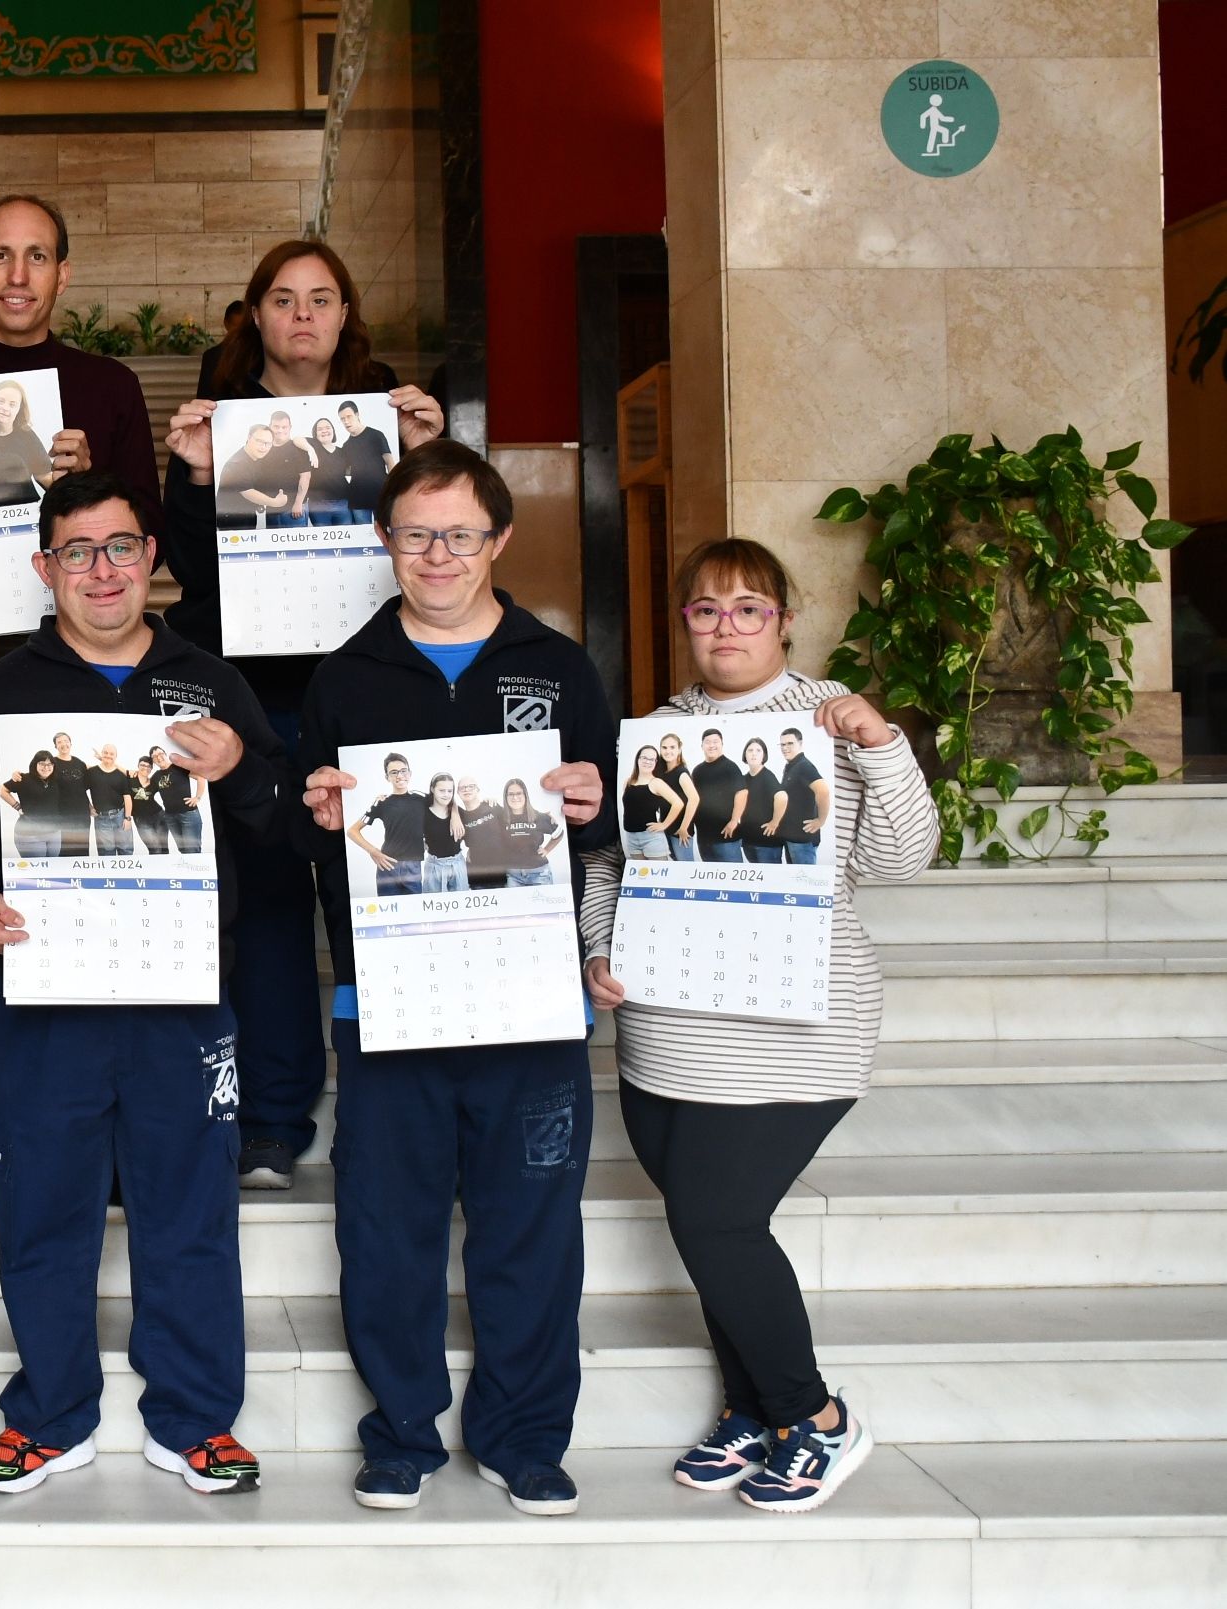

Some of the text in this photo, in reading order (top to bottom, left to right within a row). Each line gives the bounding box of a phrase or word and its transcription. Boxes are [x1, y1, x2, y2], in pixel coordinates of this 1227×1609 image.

[909, 76, 969, 91] SUBIDA
[2, 508, 30, 519] 2024
[271, 531, 351, 542] Octubre 2024
[44, 603, 54, 611] 28
[339, 620, 348, 628] 25
[152, 678, 208, 694] PRODUCCIÓN
[499, 677, 553, 688] PRODUCCIÓN
[152, 689, 215, 707] IMPRESIÓN
[497, 686, 559, 701] IMPRESIÓN
[73, 860, 142, 869] Abril 2024
[690, 870, 764, 882] Junio 2024
[104, 880, 115, 888] Ju
[137, 880, 145, 888] Vi
[170, 880, 182, 888] Sa
[203, 880, 215, 889] Do
[652, 889, 665, 897] Ma
[716, 892, 728, 900] Ju
[750, 893, 759, 902] Vi
[784, 895, 796, 904] Sa
[818, 897, 832, 906] Do
[423, 895, 498, 913] Mayo 2024
[41, 918, 150, 928] 9 10 12
[353, 927, 401, 937] Lu Ma
[462, 936, 502, 949] 2 3
[648, 945, 825, 968] 11 12 13 14 15 16
[429, 957, 506, 972] 8 9 10
